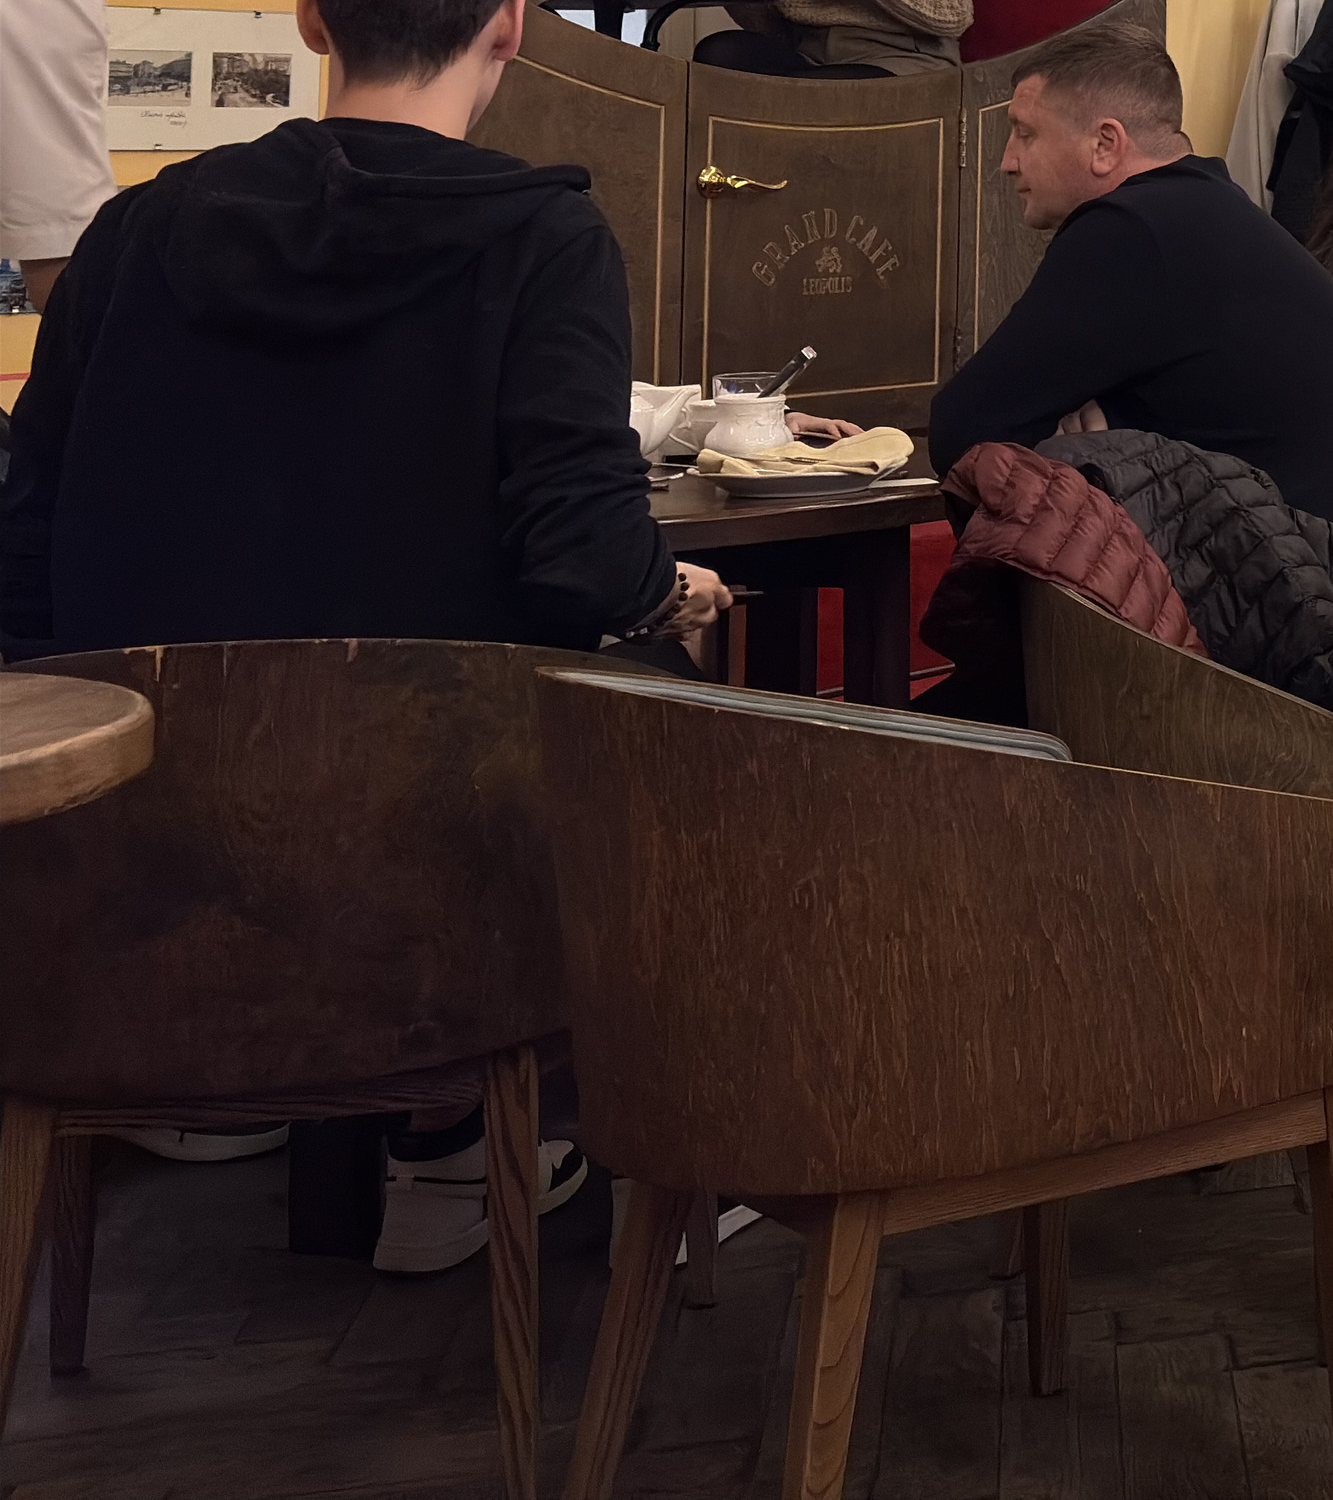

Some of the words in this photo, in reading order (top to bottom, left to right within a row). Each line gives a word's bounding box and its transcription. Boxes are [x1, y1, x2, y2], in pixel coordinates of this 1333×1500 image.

[752, 208, 839, 287] GRAND
[845, 214, 900, 281] CAFE
[802, 275, 853, 296] LEOPOLIS
